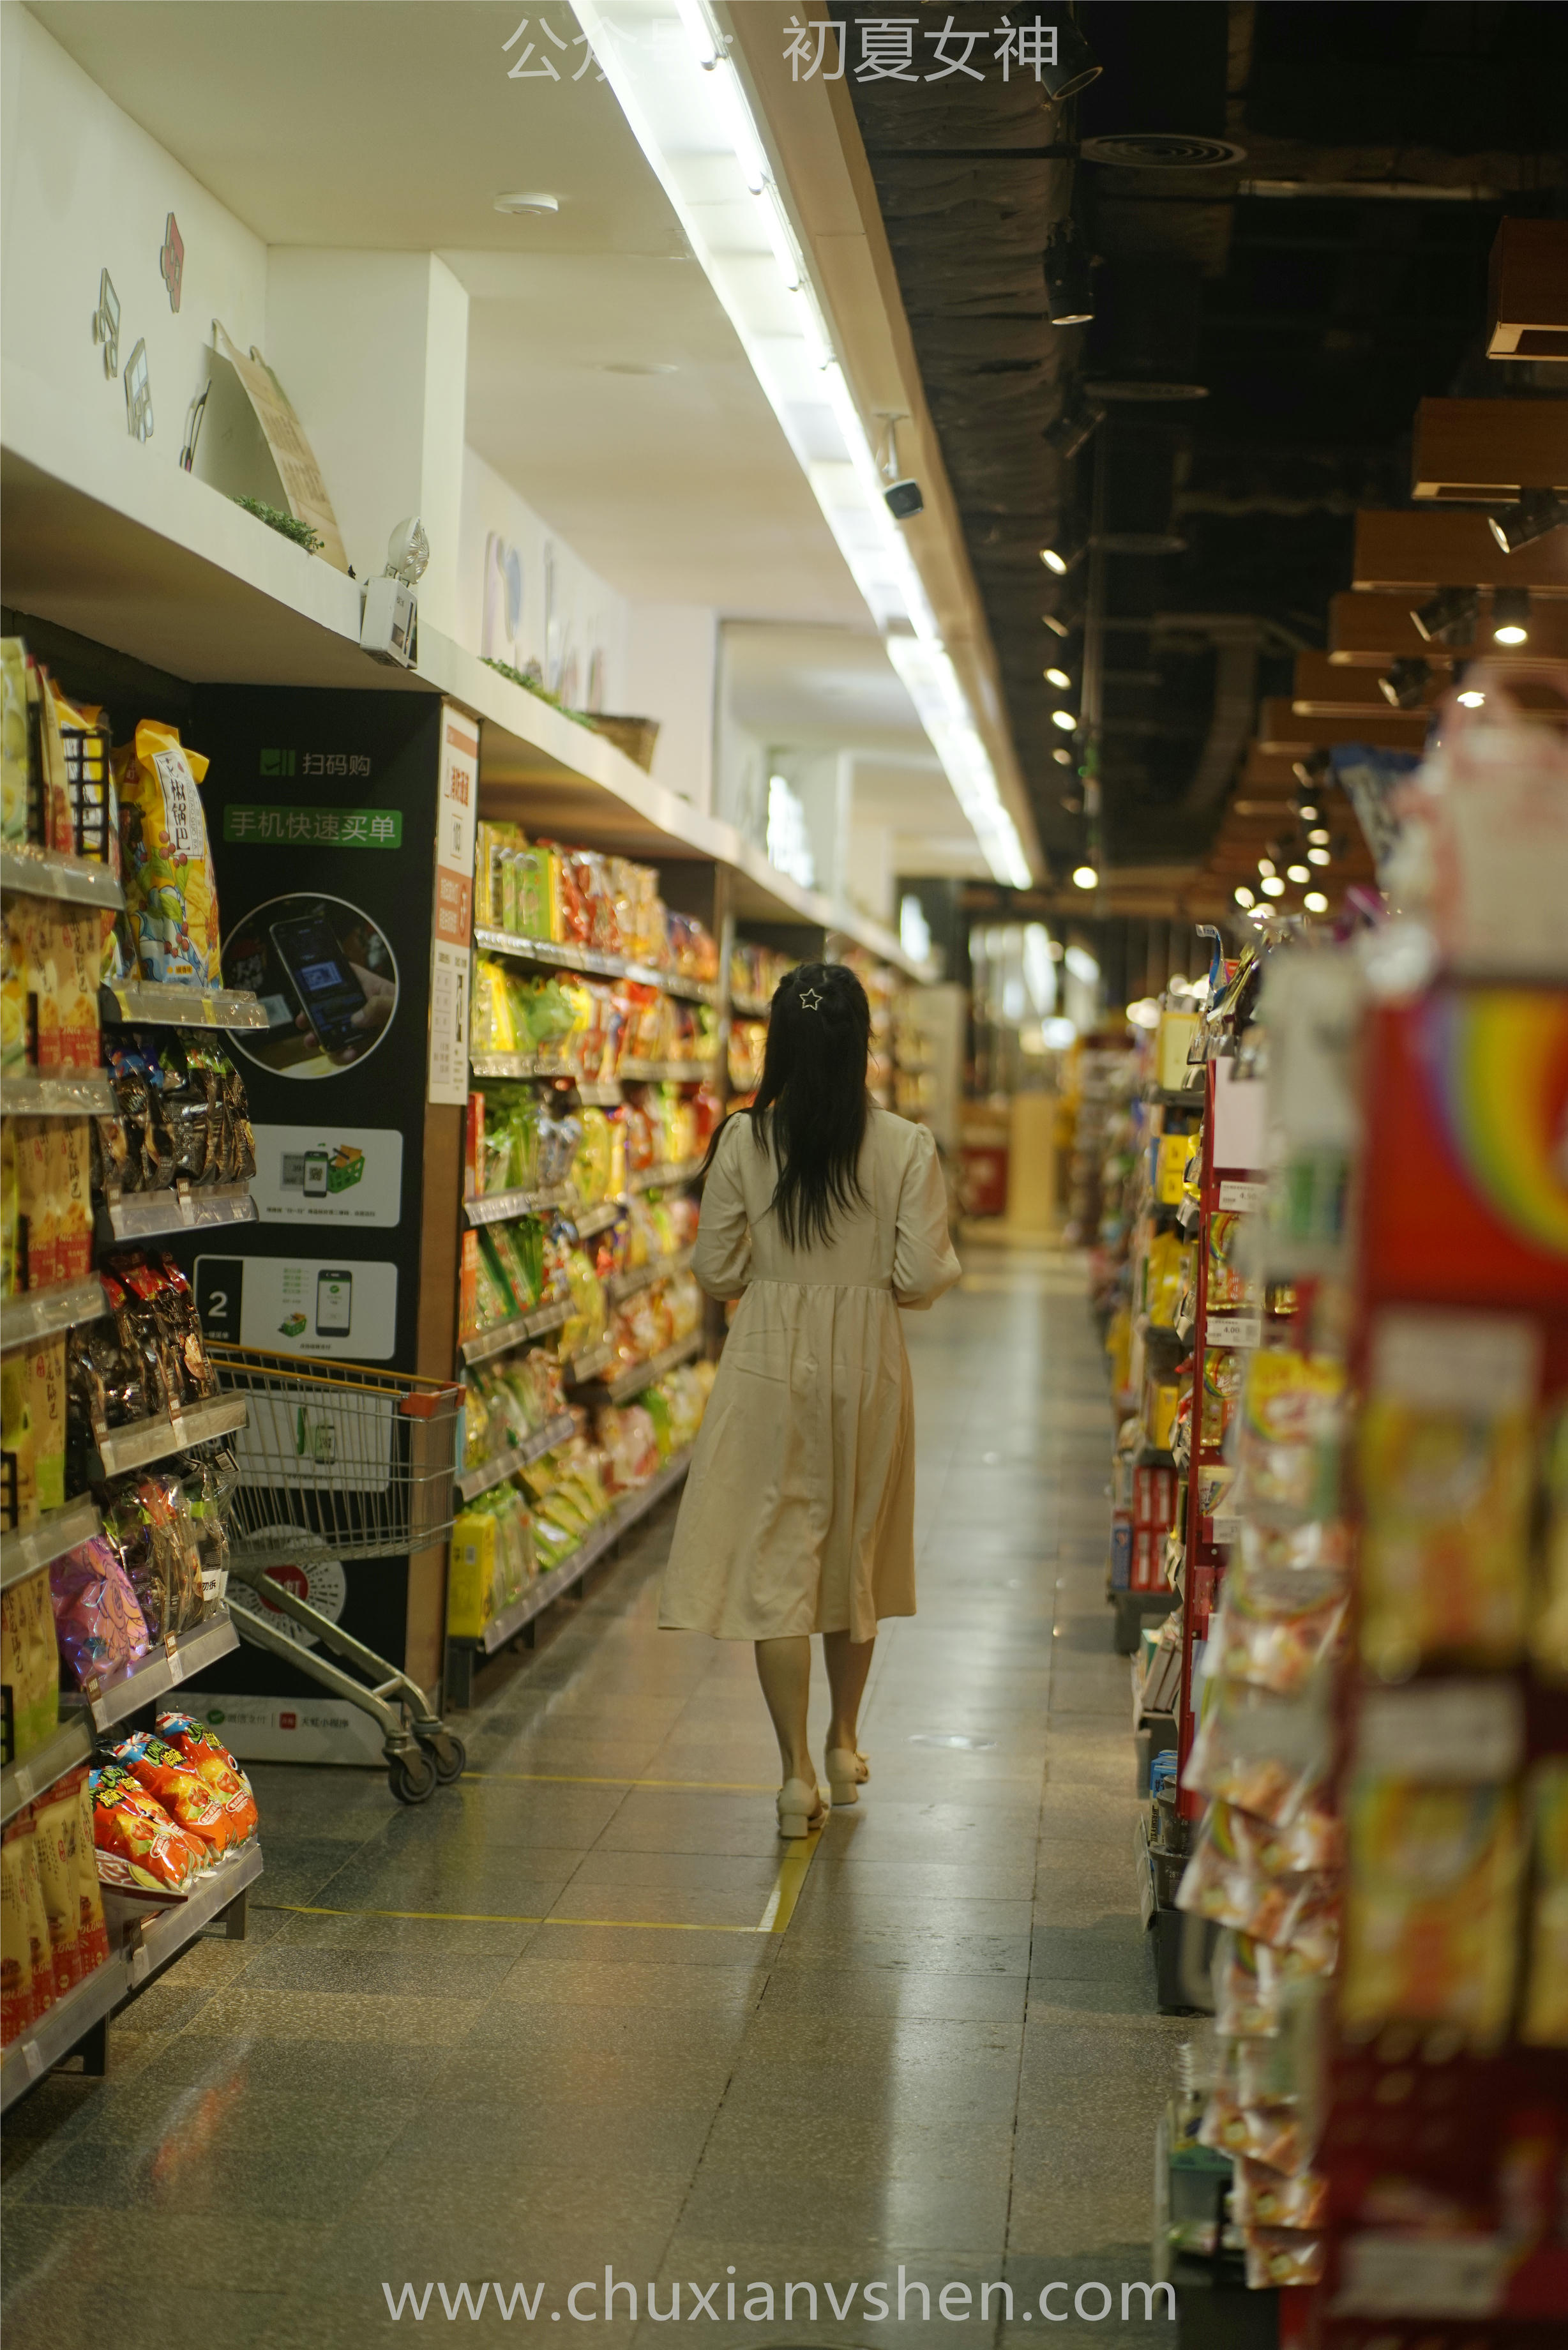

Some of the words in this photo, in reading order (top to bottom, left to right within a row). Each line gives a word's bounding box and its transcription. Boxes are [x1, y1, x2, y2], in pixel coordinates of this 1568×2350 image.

[303, 752, 370, 777] 扫码购
[230, 810, 395, 842] 手机快速买单
[207, 1291, 228, 1317] 2
